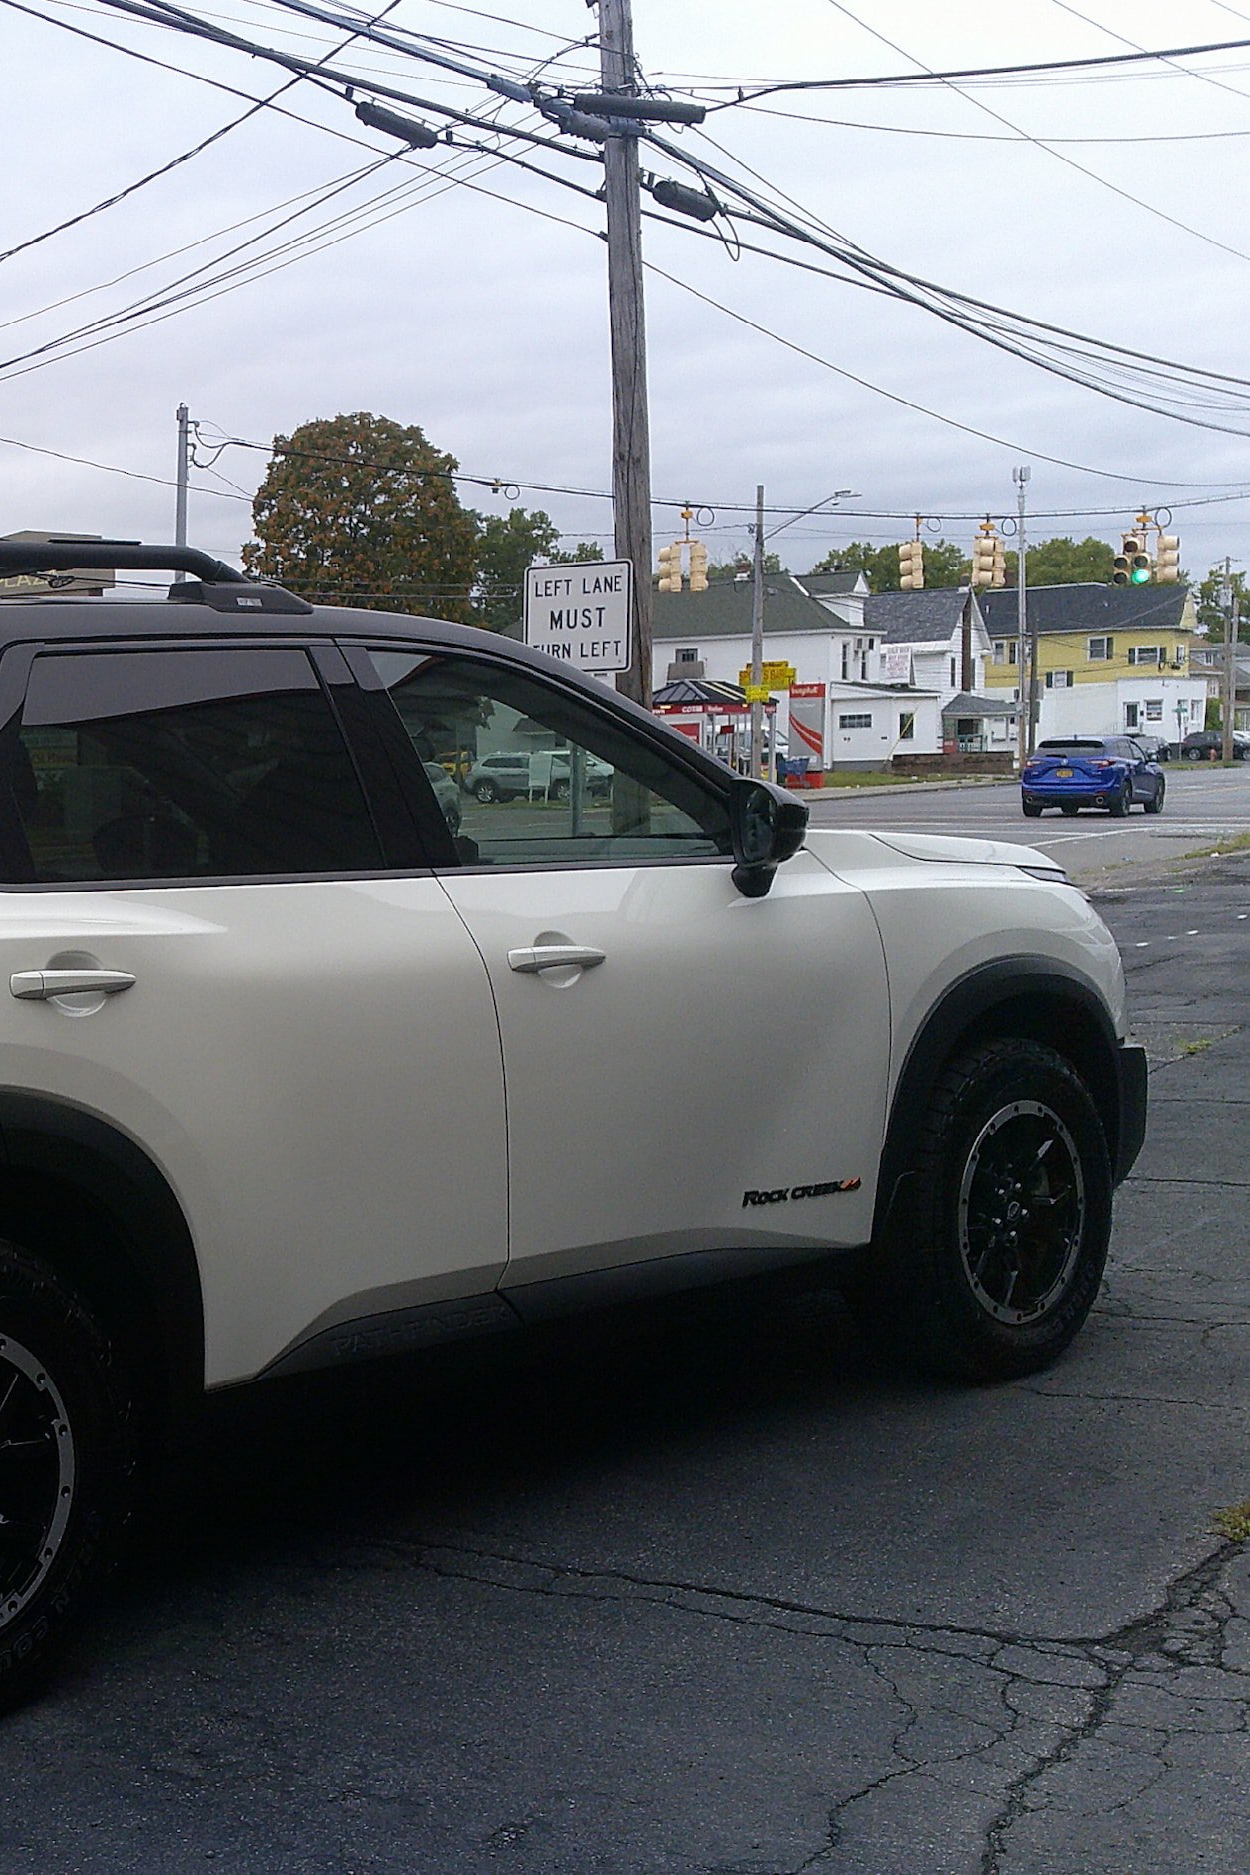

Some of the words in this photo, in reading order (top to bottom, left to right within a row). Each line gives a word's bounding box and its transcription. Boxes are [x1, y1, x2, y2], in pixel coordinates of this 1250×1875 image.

[535, 579, 572, 598] LEFT
[582, 575, 622, 594] LANE
[550, 607, 606, 630] MUST
[580, 640, 621, 658] LEFT
